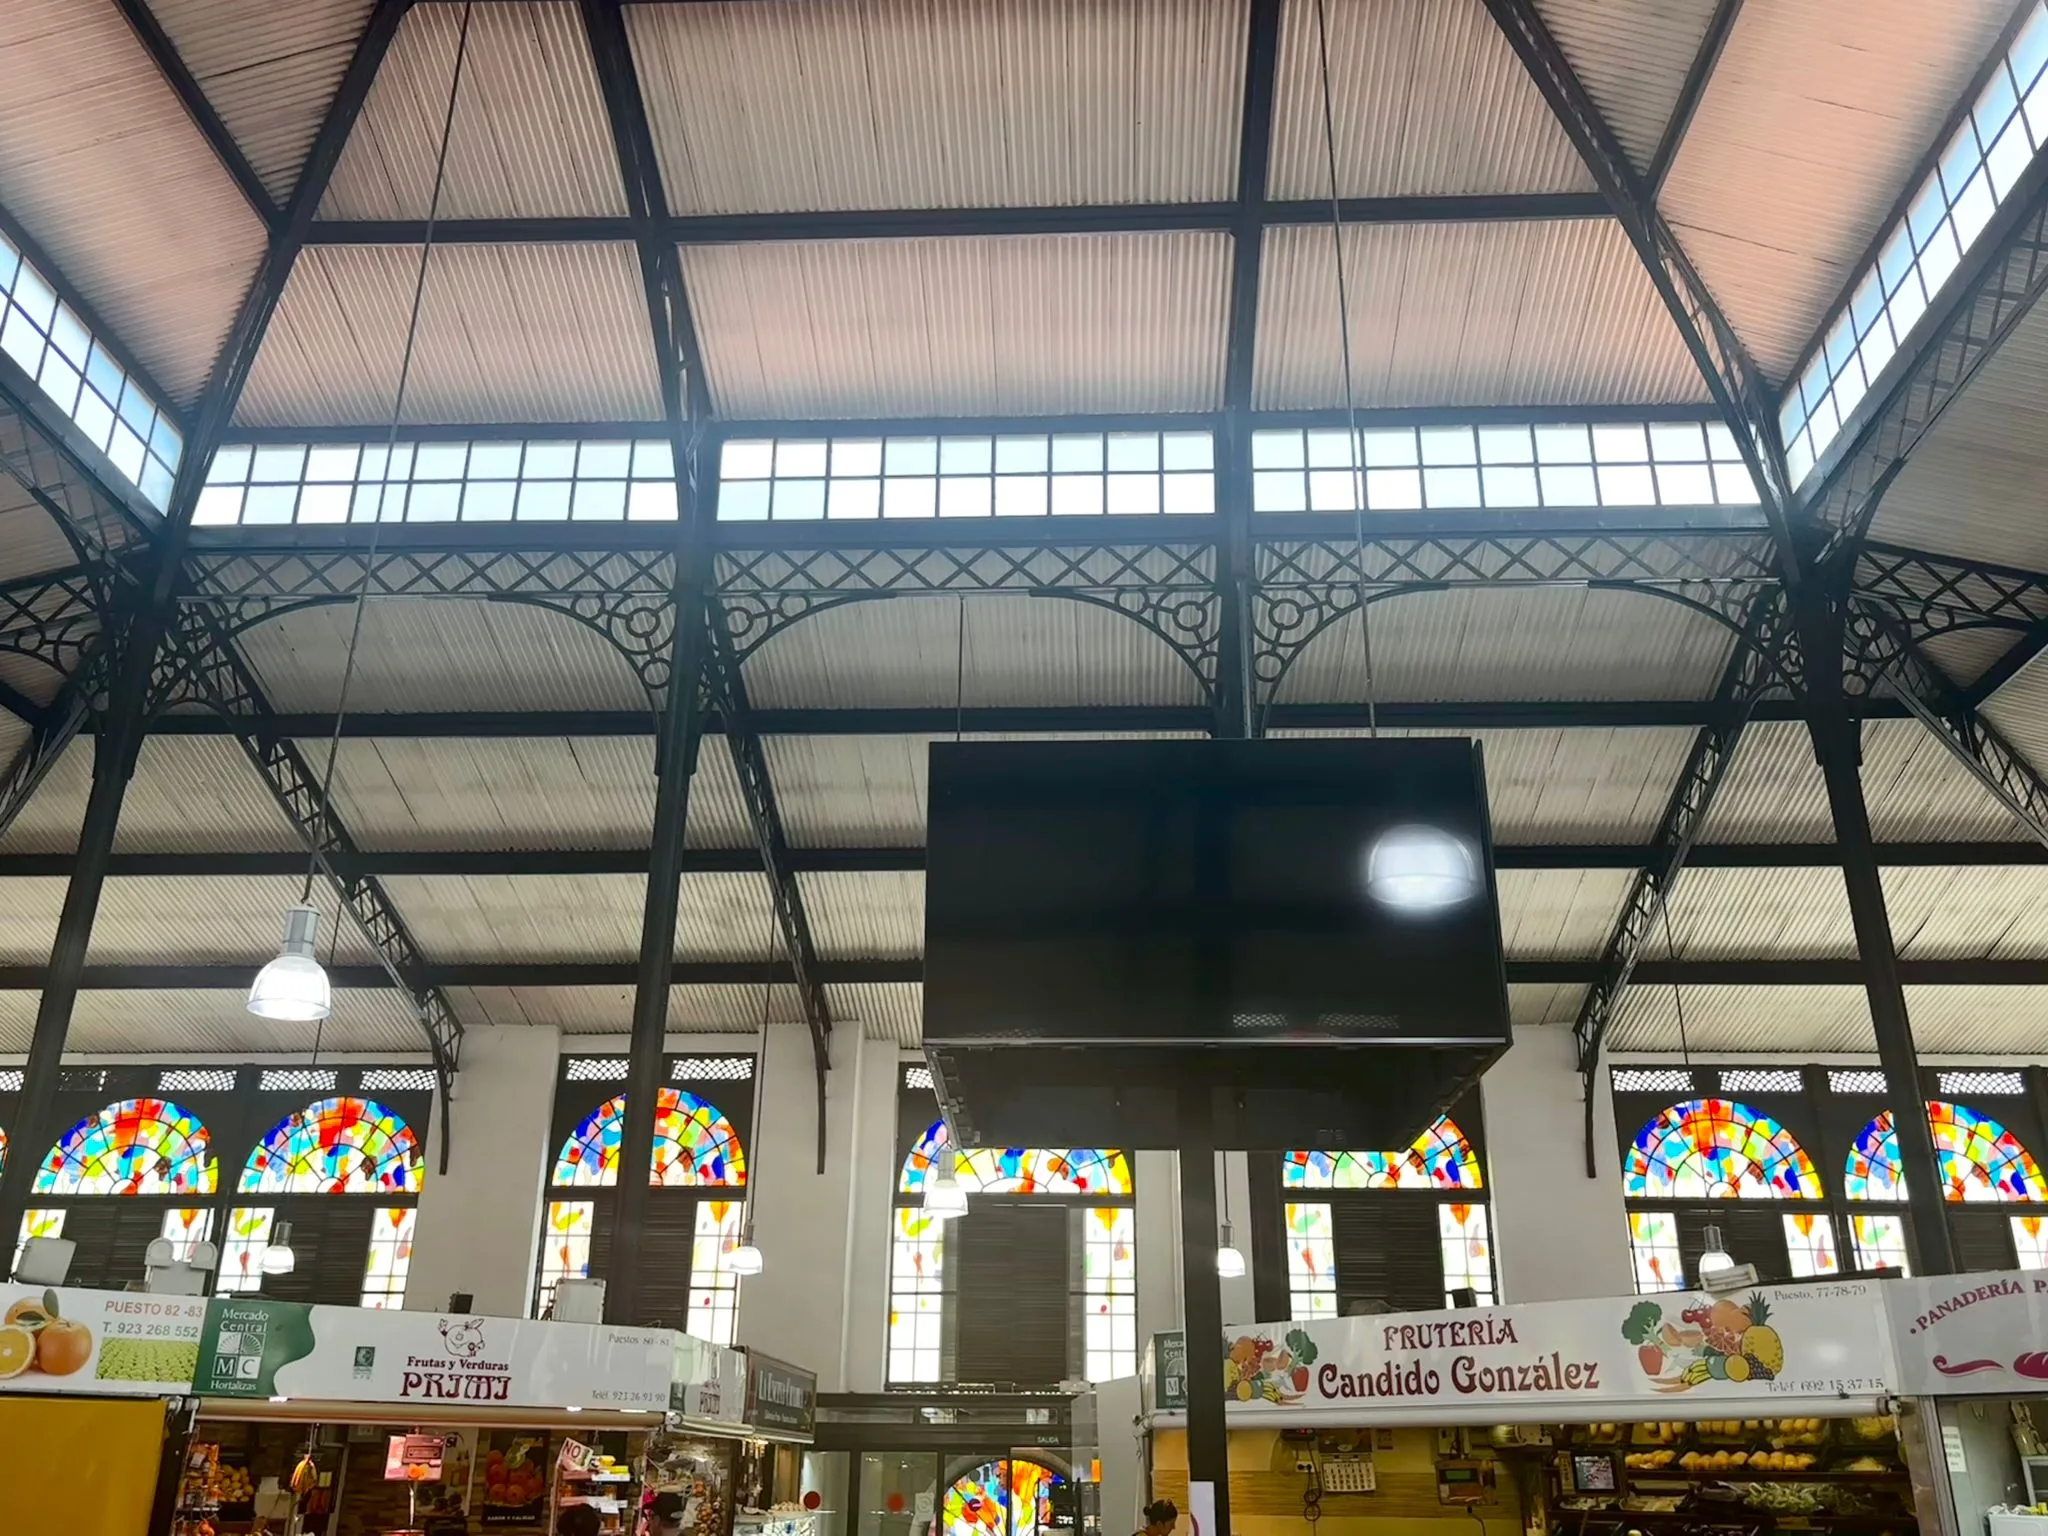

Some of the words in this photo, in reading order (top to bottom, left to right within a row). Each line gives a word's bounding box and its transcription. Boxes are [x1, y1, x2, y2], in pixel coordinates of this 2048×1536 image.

[1816, 1284, 1867, 1298] 77-78-79
[104, 1301, 162, 1316] PUESTO
[165, 1304, 180, 1317] 82
[1916, 1278, 2024, 1331] PANADERÍA
[2034, 1279, 2048, 1293] P
[222, 1308, 269, 1321] Mercado
[102, 1322, 112, 1333] T.
[117, 1322, 142, 1334] 923
[146, 1324, 170, 1336] 268
[174, 1326, 199, 1338] 552
[220, 1321, 268, 1333] Central
[1383, 1313, 1519, 1351] FRUTERÍA
[608, 1333, 639, 1345] Puestos
[407, 1355, 446, 1369] Frutas
[448, 1360, 456, 1370] y
[460, 1359, 509, 1371] Verduras
[1317, 1359, 1440, 1399] Candido
[1451, 1351, 1600, 1394] González
[210, 1379, 256, 1391] Hortalizas
[399, 1371, 512, 1400] PRIMI
[1868, 1378, 1884, 1389] 15
[655, 1392, 666, 1403] 90
[562, 1440, 581, 1459] NO
